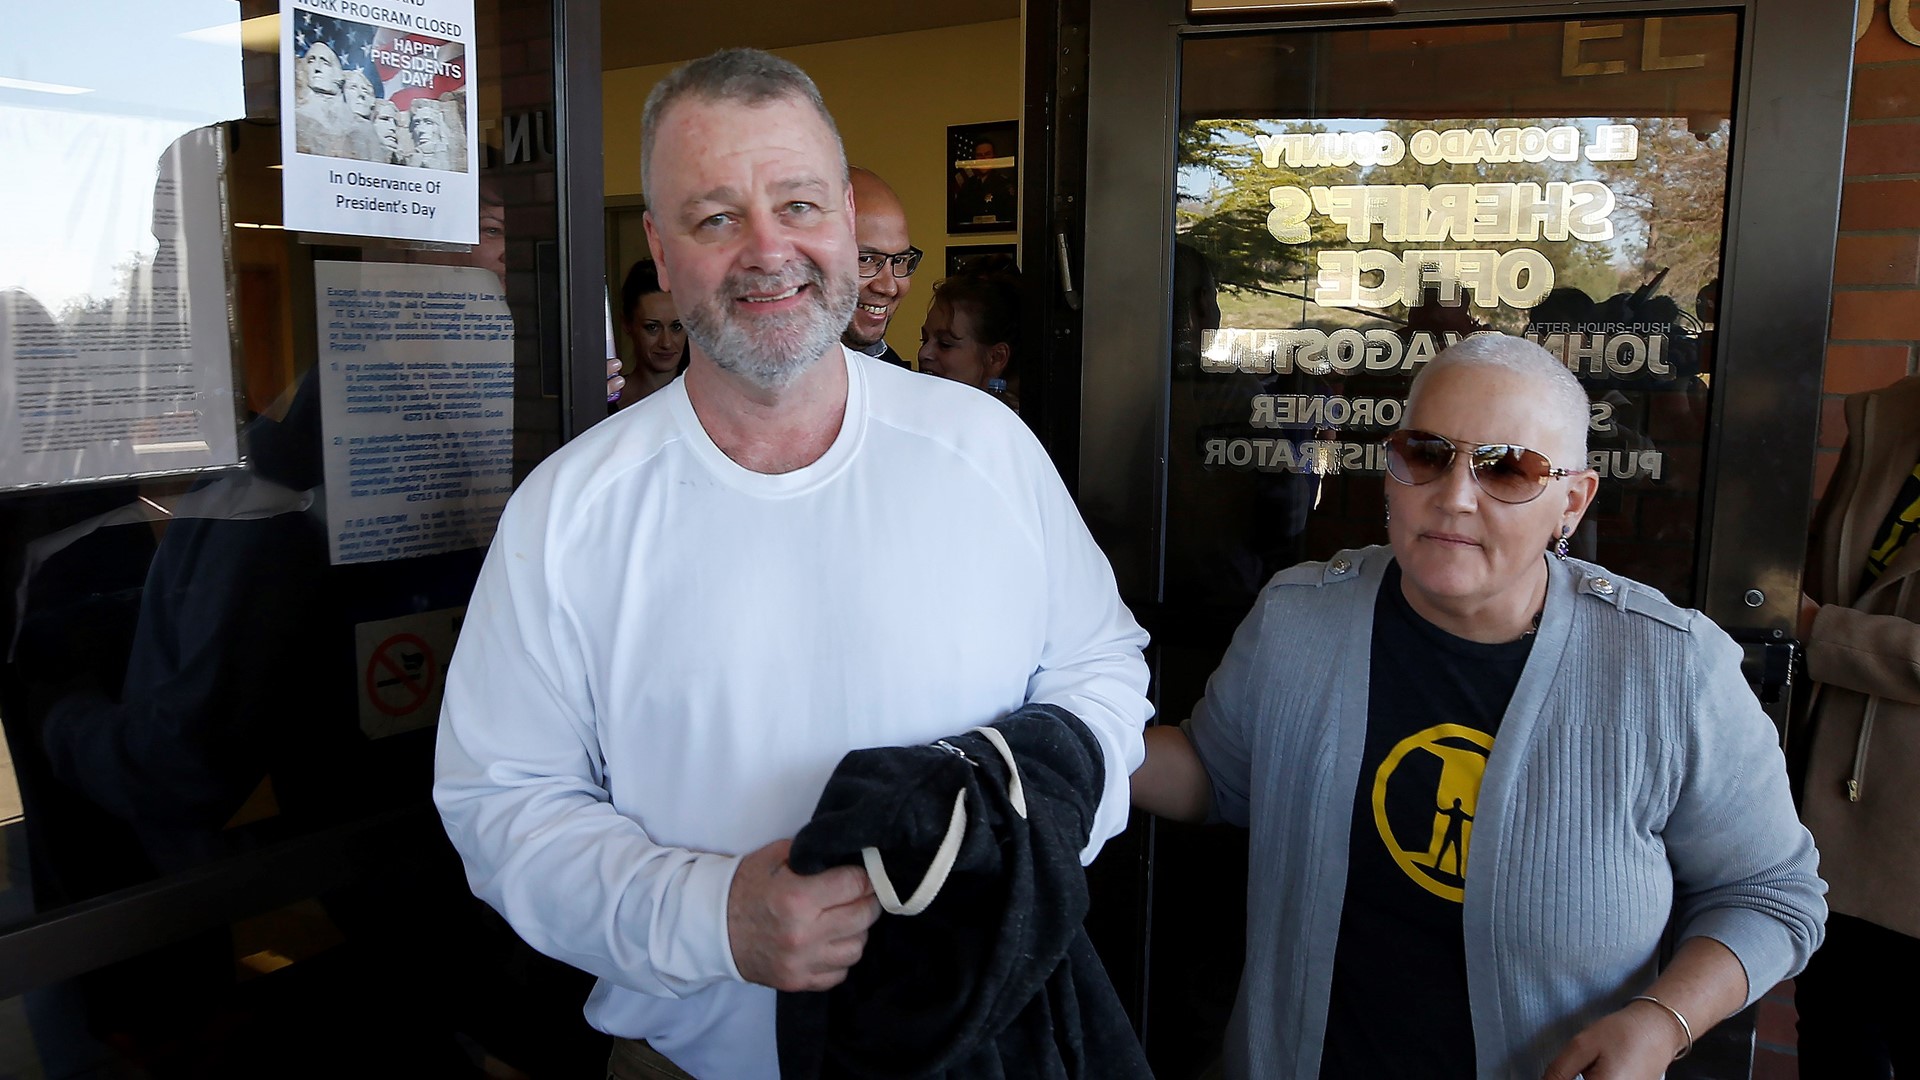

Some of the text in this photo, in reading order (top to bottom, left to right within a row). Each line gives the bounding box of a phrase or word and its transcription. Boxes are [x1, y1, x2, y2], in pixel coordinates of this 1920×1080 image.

[342, 1, 412, 27] PROGRAM
[415, 16, 461, 37] CLOSED
[394, 38, 440, 60] HAPPY
[370, 50, 462, 79] PRESIDENTS
[402, 70, 434, 89] DAY!
[330, 170, 441, 194] In Observance Of
[336, 195, 436, 219] President's Day
[427, 291, 466, 300] authorized
[388, 301, 401, 309] the
[405, 301, 417, 309] Jail
[421, 301, 465, 310] Commander
[369, 310, 399, 318] FELONY
[424, 313, 461, 321] knowingly
[464, 313, 482, 321] bring
[351, 322, 390, 330] knowingly
[431, 322, 460, 331] bringing
[474, 322, 501, 331] sending
[1528, 322, 1671, 334] AFTER HOURS-PUSH
[342, 332, 361, 340] have
[376, 333, 392, 341] your
[396, 333, 440, 341] possession
[443, 332, 461, 340] while
[474, 332, 486, 340] the
[331, 343, 366, 352] Property
[364, 362, 404, 370] controlled
[402, 403, 441, 411] controlled
[486, 410, 503, 418] Code
